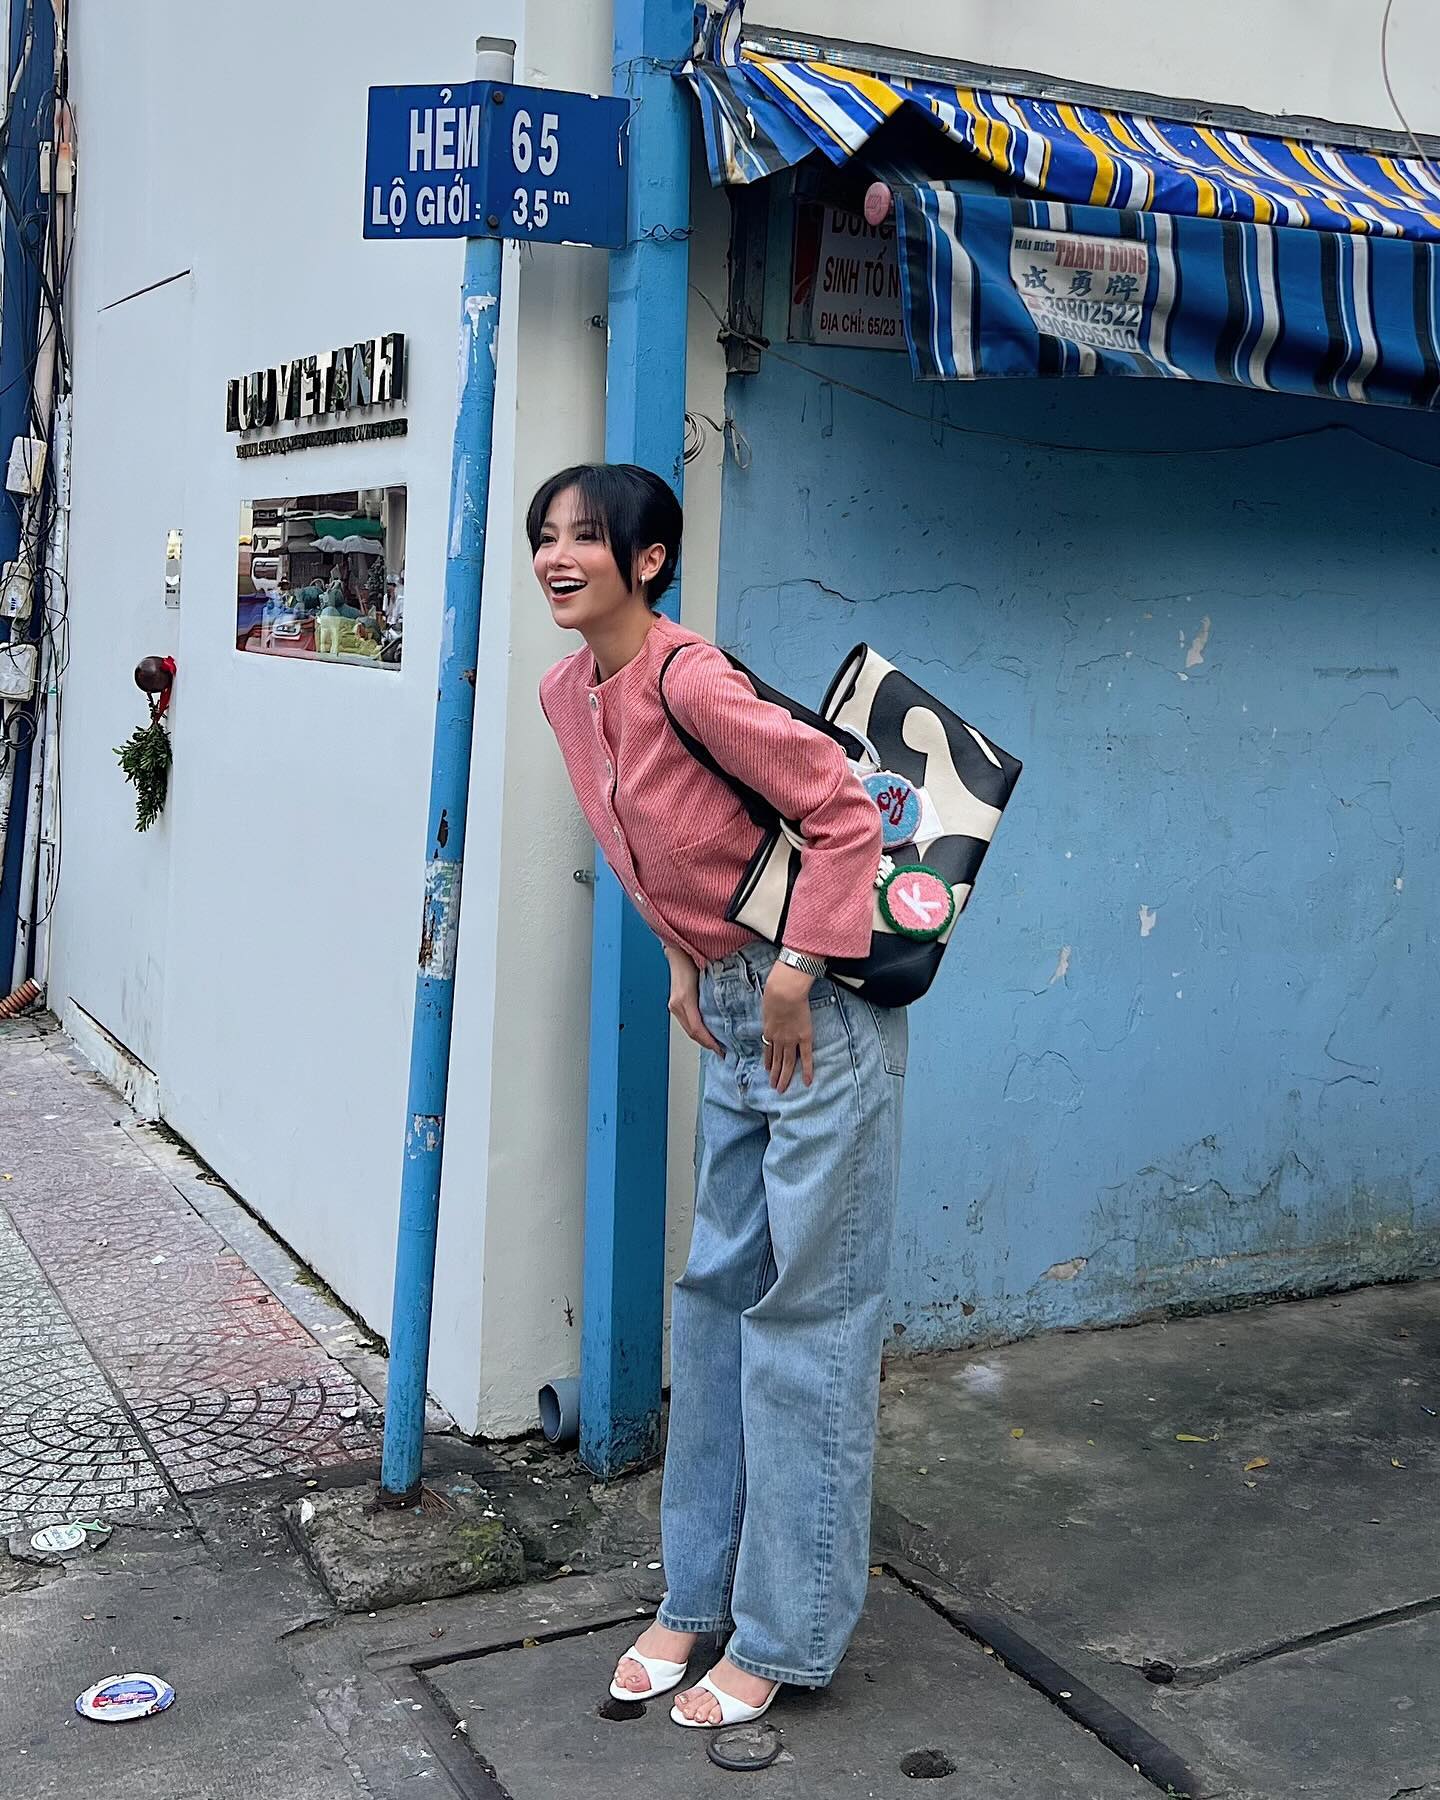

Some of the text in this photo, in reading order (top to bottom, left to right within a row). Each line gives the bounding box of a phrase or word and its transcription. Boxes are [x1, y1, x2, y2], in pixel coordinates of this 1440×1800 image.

[409, 88, 559, 177] HẺM 65
[372, 177, 407, 233] LỘ
[823, 256, 860, 295] SINH
[865, 246, 887, 297] TỐ
[820, 312, 838, 335] ĐỊA
[842, 308, 864, 334] CHỈ:
[867, 316, 896, 336] 65/23
[896, 882, 942, 923] K
